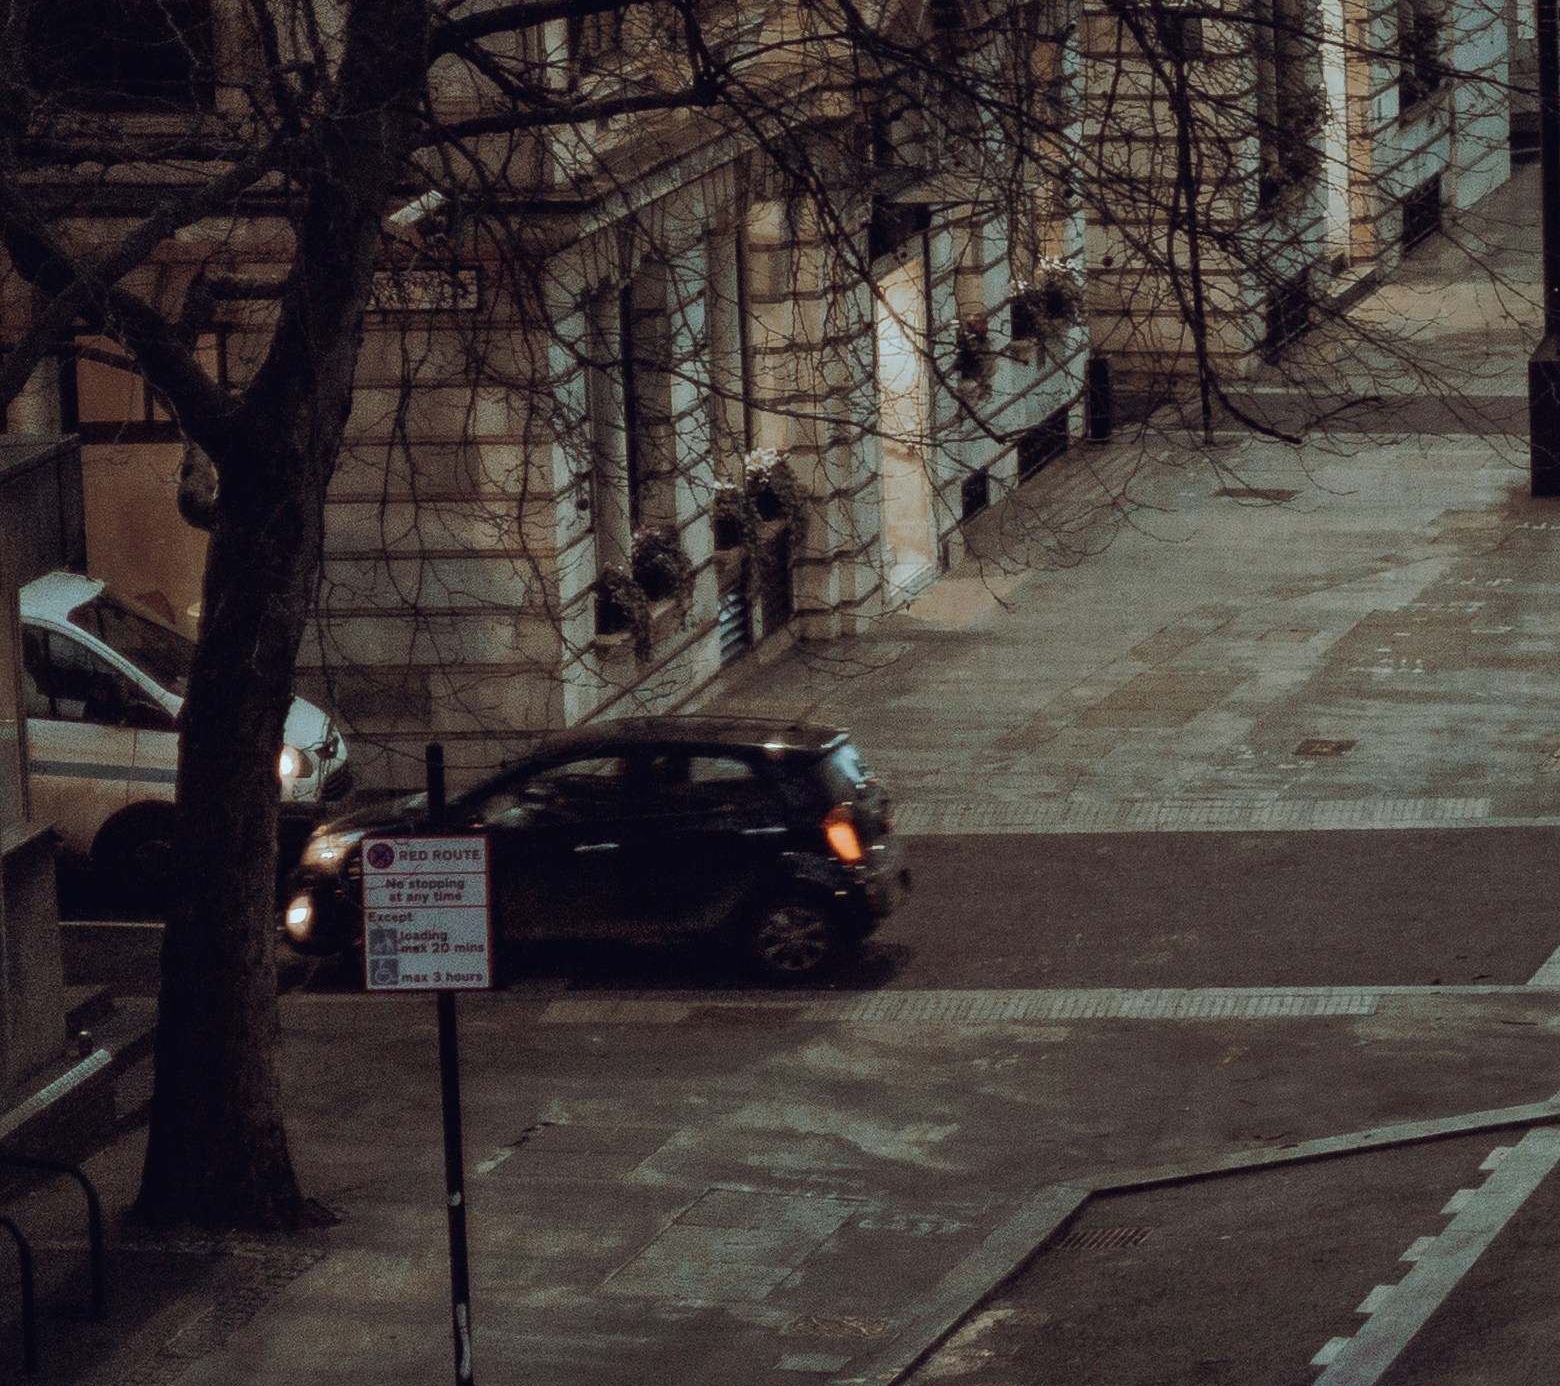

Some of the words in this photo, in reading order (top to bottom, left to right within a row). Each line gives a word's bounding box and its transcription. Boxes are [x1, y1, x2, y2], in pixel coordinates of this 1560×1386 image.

[399, 850, 428, 861] RED
[432, 849, 482, 861] ROUTE
[386, 879, 404, 889] No
[409, 878, 465, 890] stopping
[388, 893, 402, 902] at
[406, 894, 429, 903] any
[434, 892, 462, 901] time
[368, 912, 414, 923] Except
[400, 931, 448, 943] loading
[432, 943, 450, 953] 20
[454, 943, 484, 953] mins
[402, 973, 428, 983] max
[433, 972, 442, 982] 3
[446, 971, 483, 982] hours
